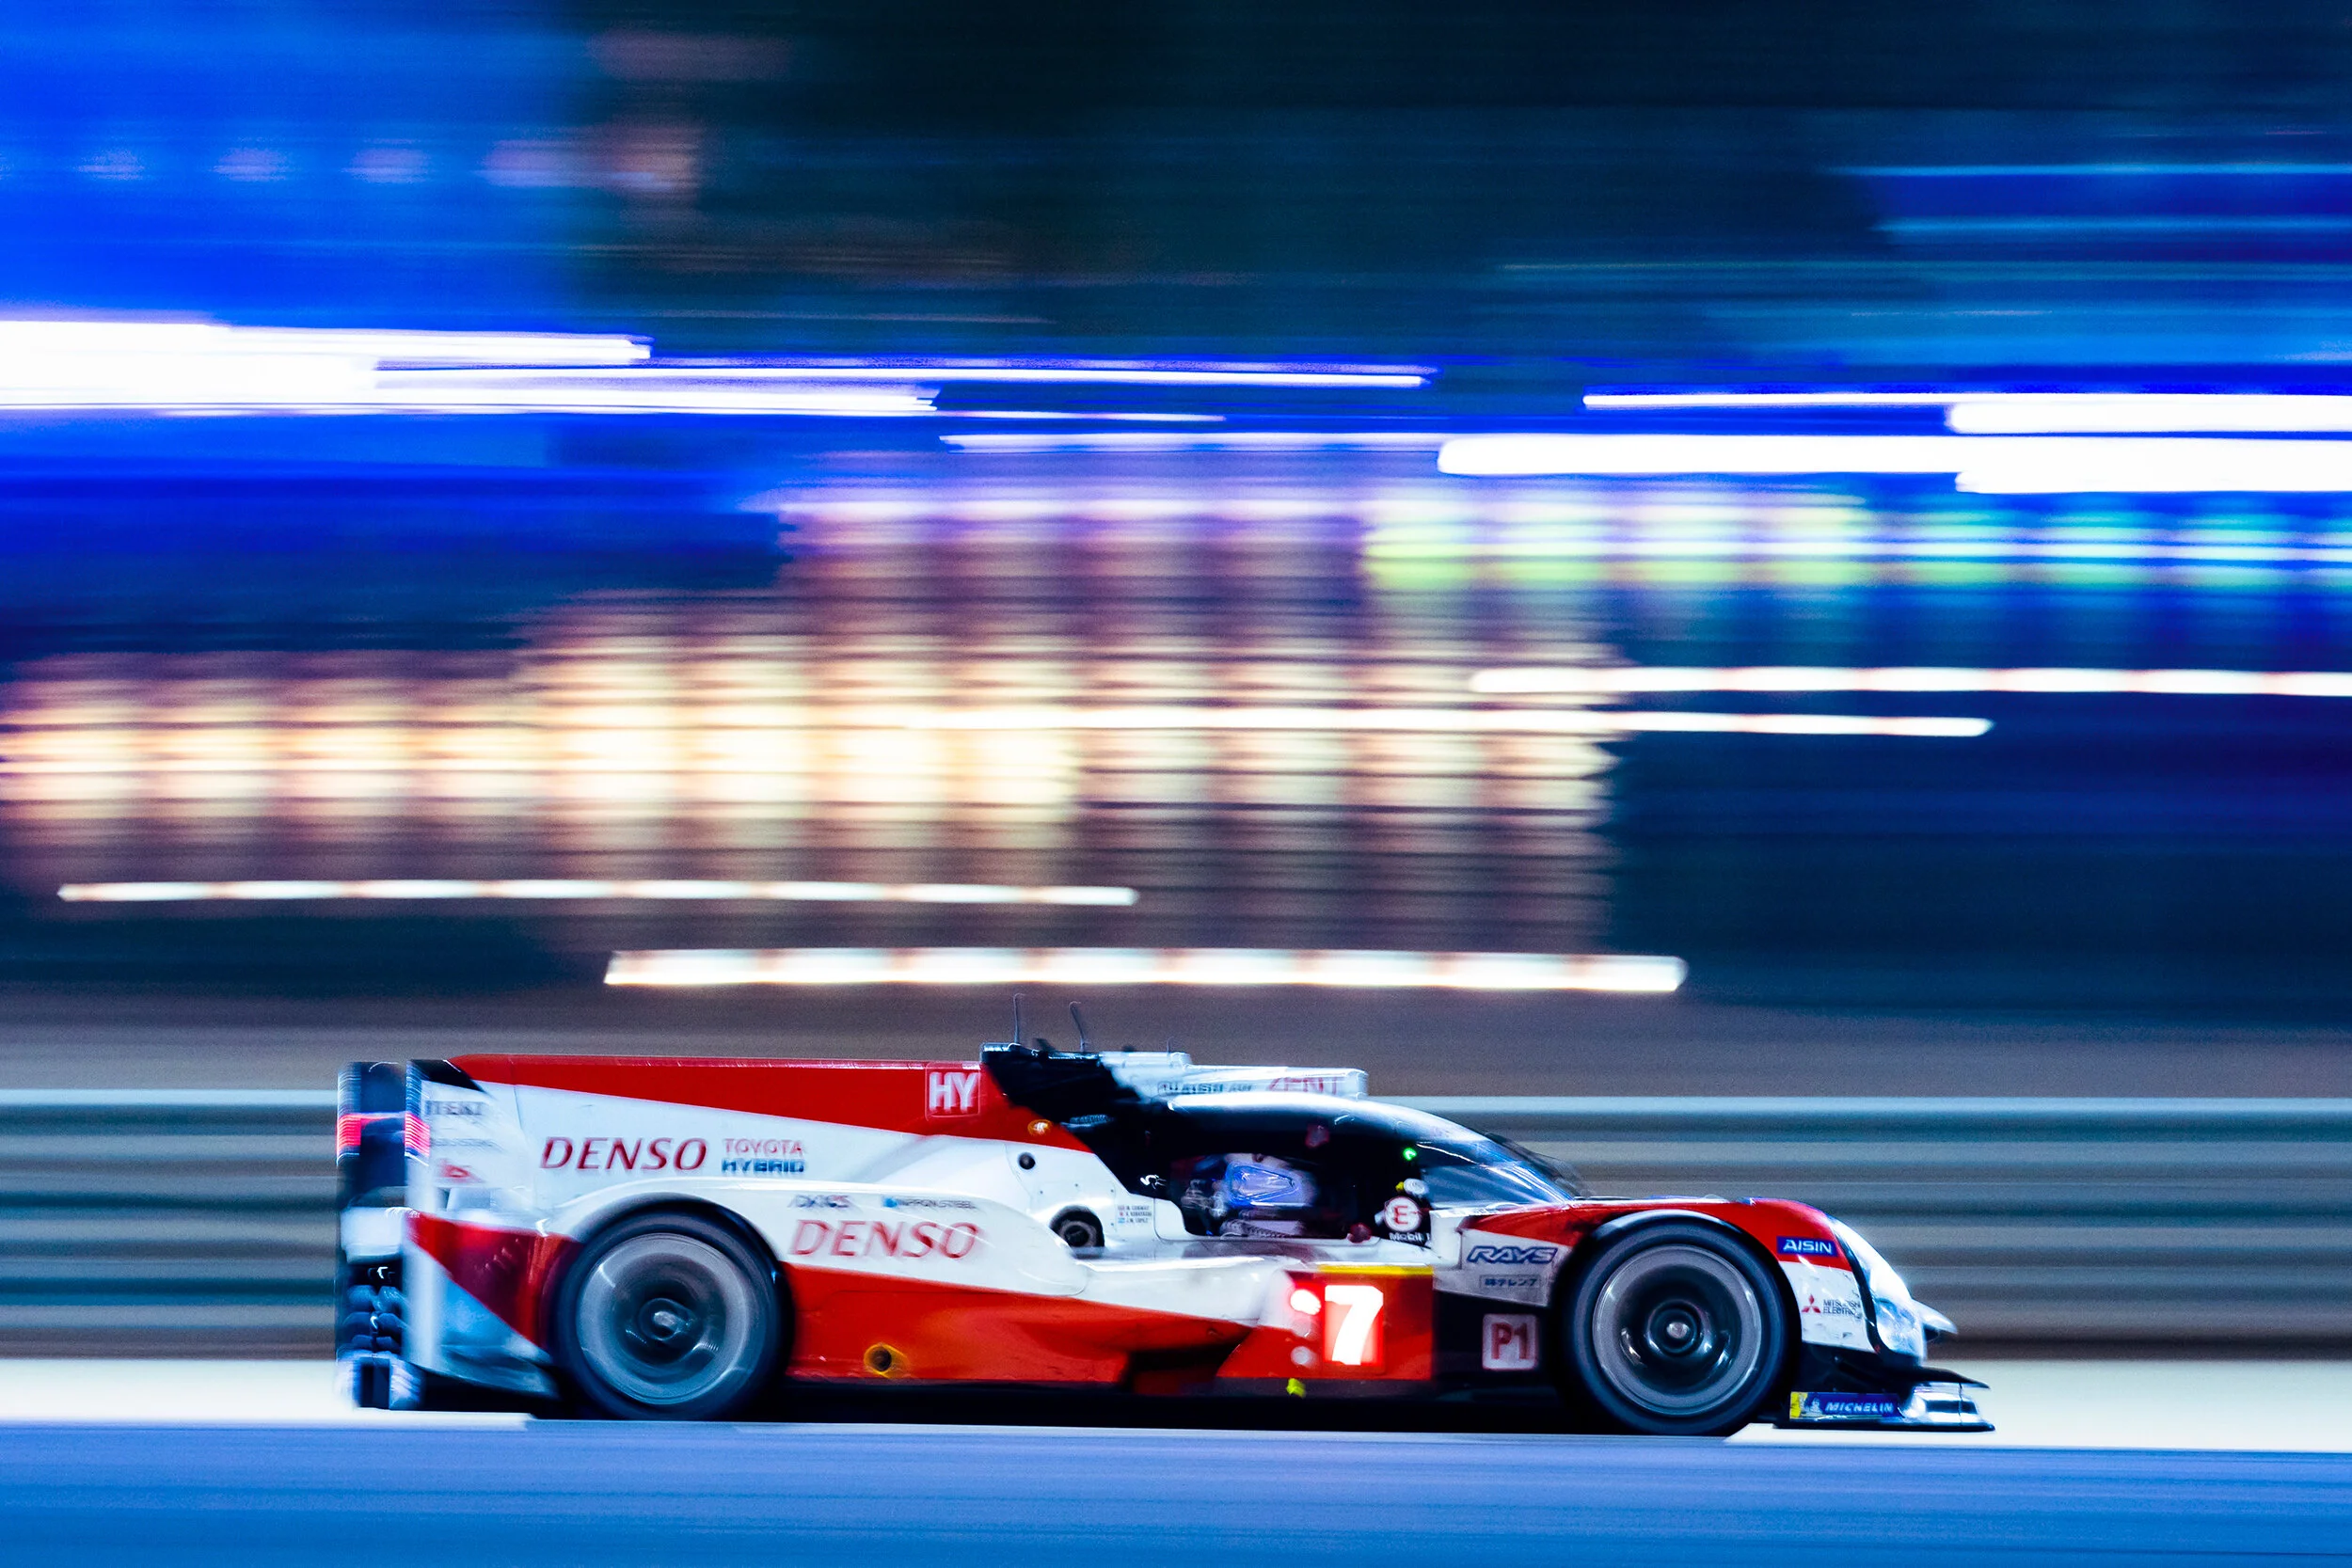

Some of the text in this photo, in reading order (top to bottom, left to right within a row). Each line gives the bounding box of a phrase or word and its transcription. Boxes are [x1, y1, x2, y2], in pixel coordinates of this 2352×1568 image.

[929, 1071, 980, 1111] HY
[538, 1135, 707, 1171] DENSO
[723, 1137, 804, 1155] TOYOTA
[721, 1158, 805, 1173] HYBRID
[788, 1219, 980, 1259] DENSO
[1783, 1239, 1834, 1255] AISIN
[1467, 1245, 1558, 1264] RAYS
[1822, 1299, 1861, 1308] MITSISHI
[1325, 1285, 1384, 1366] 7
[1491, 1322, 1528, 1360] P1
[1824, 1402, 1894, 1413] MICHELIN
